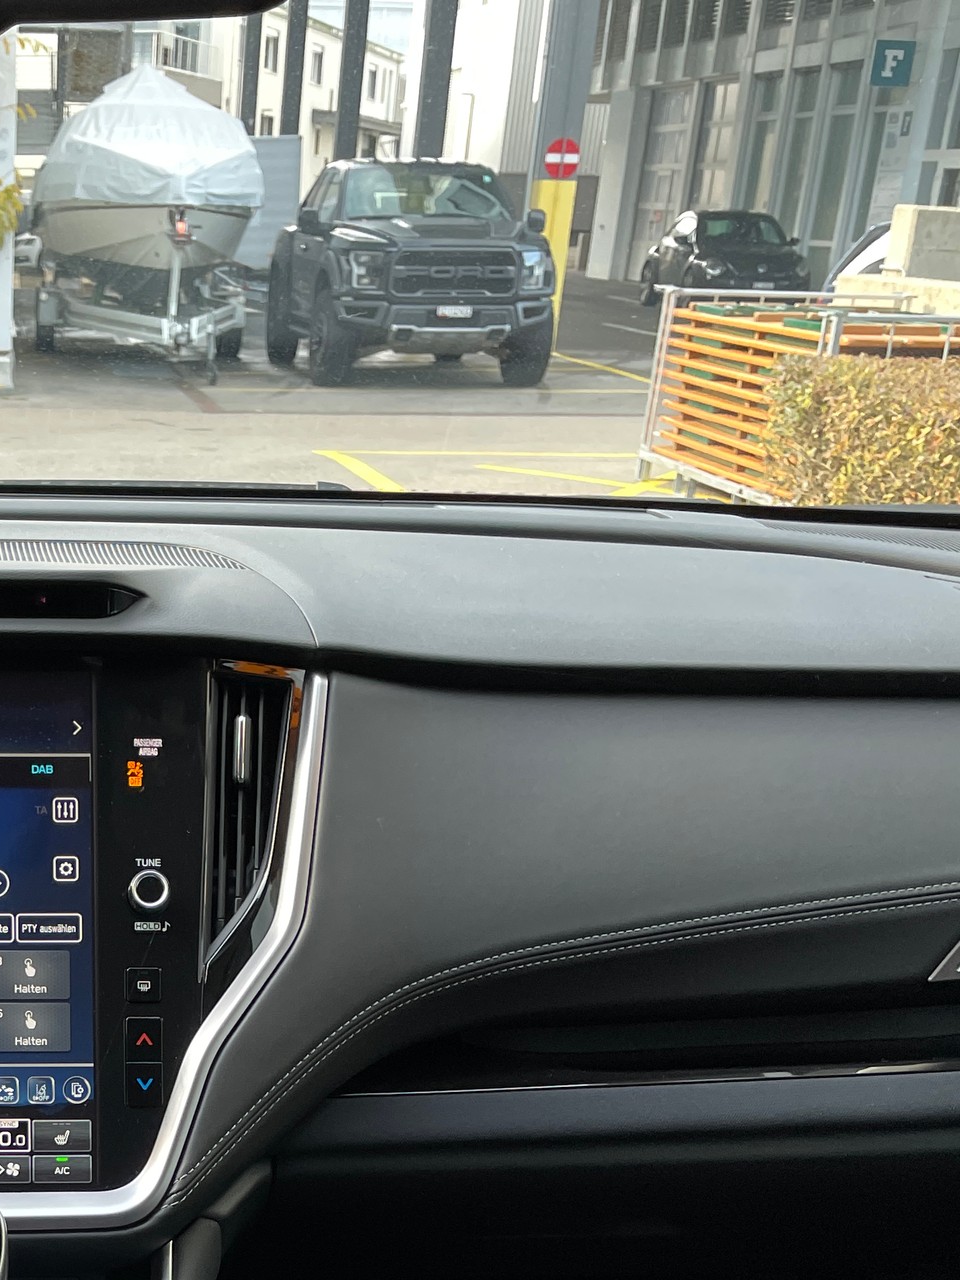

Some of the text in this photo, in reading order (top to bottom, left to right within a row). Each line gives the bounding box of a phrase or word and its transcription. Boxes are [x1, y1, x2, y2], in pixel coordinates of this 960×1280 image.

[881, 49, 904, 77] F
[394, 266, 515, 278] FORD
[139, 747, 158, 756] AIRBAG
[31, 765, 54, 774] DAB
[135, 858, 162, 867] TUNE
[21, 924, 77, 934] PTY auswählen
[14, 984, 48, 994] Halten
[15, 1036, 48, 1046] Halten
[54, 1167, 71, 1175] A/C
